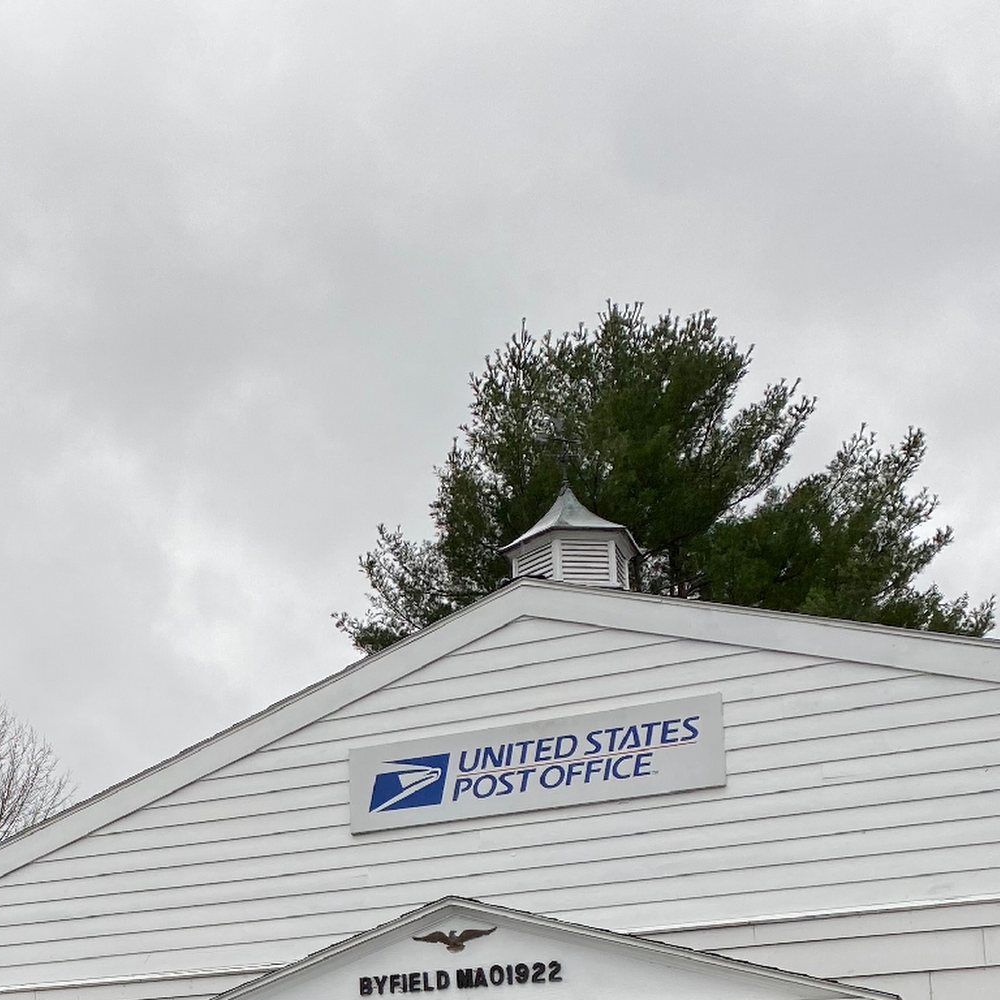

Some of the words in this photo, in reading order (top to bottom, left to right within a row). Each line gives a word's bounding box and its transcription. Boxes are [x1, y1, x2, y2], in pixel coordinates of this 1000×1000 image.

[457, 734, 578, 773] UNITED
[583, 715, 700, 755] STATES
[451, 767, 536, 802] POST
[539, 752, 653, 789] OFFICE
[359, 970, 450, 996] BYFIELD
